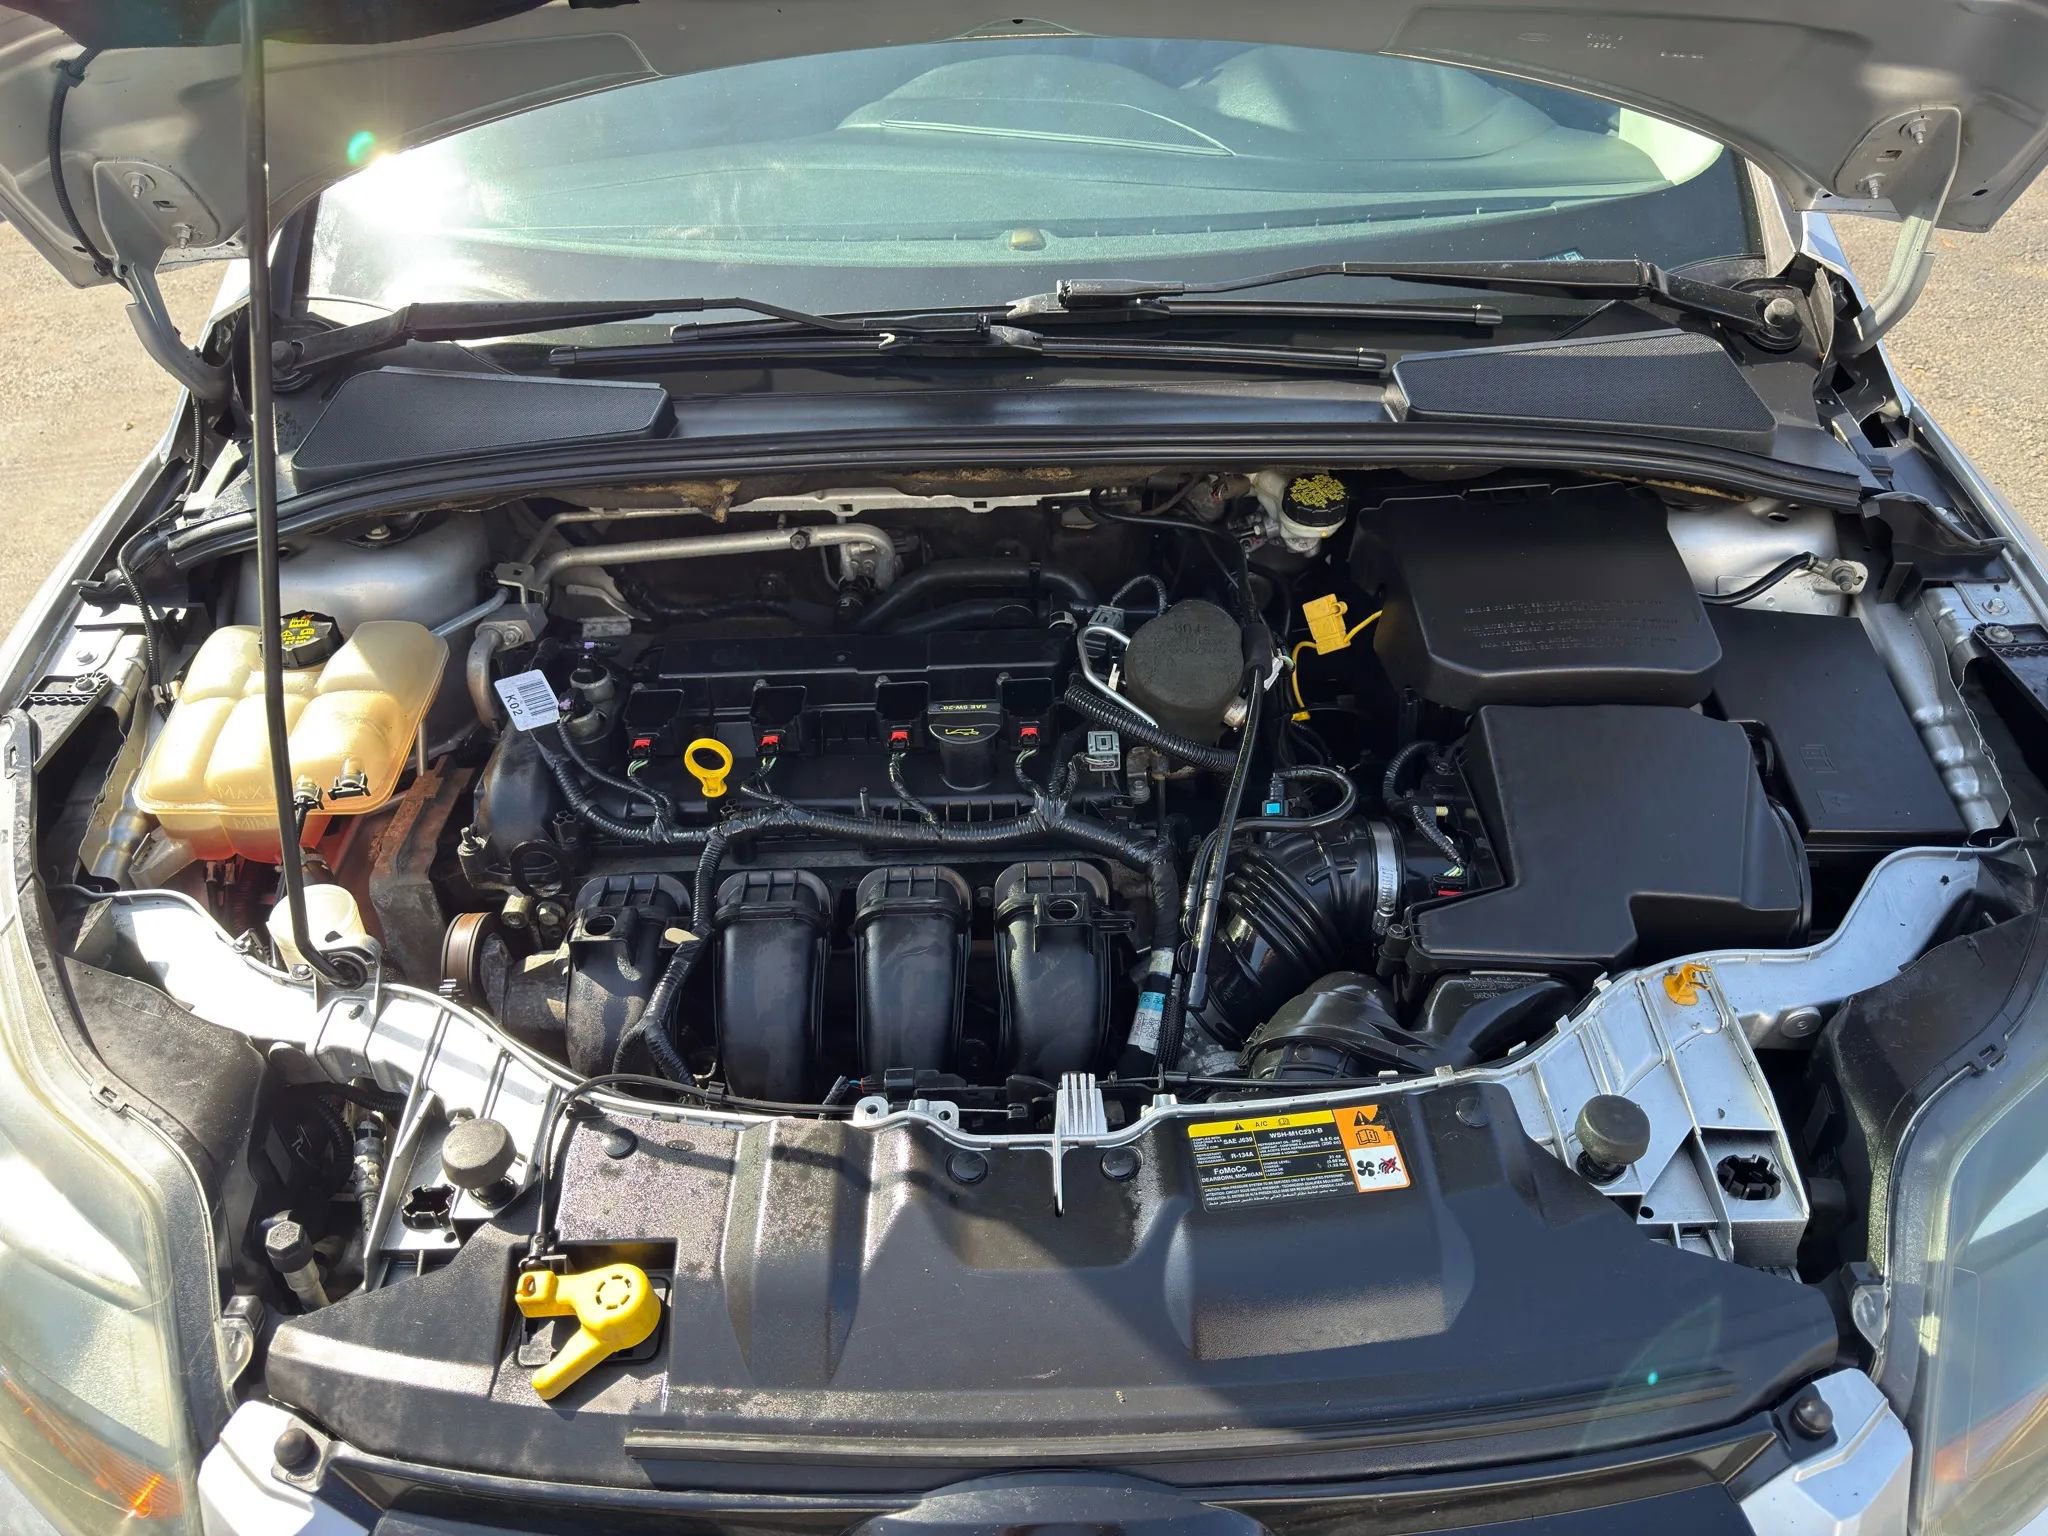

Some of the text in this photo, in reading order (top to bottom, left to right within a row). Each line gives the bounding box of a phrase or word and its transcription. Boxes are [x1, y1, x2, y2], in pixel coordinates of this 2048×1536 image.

[505, 694, 524, 717] K02
[215, 783, 265, 800] MAX
[1255, 1120, 1269, 1128] A/C
[1269, 1127, 1324, 1139] WSH-M1C231-B
[1230, 1151, 1255, 1160] R-134A
[1213, 1165, 1248, 1176] FoMoCo
[1235, 1171, 1264, 1179] MICHIGAN
